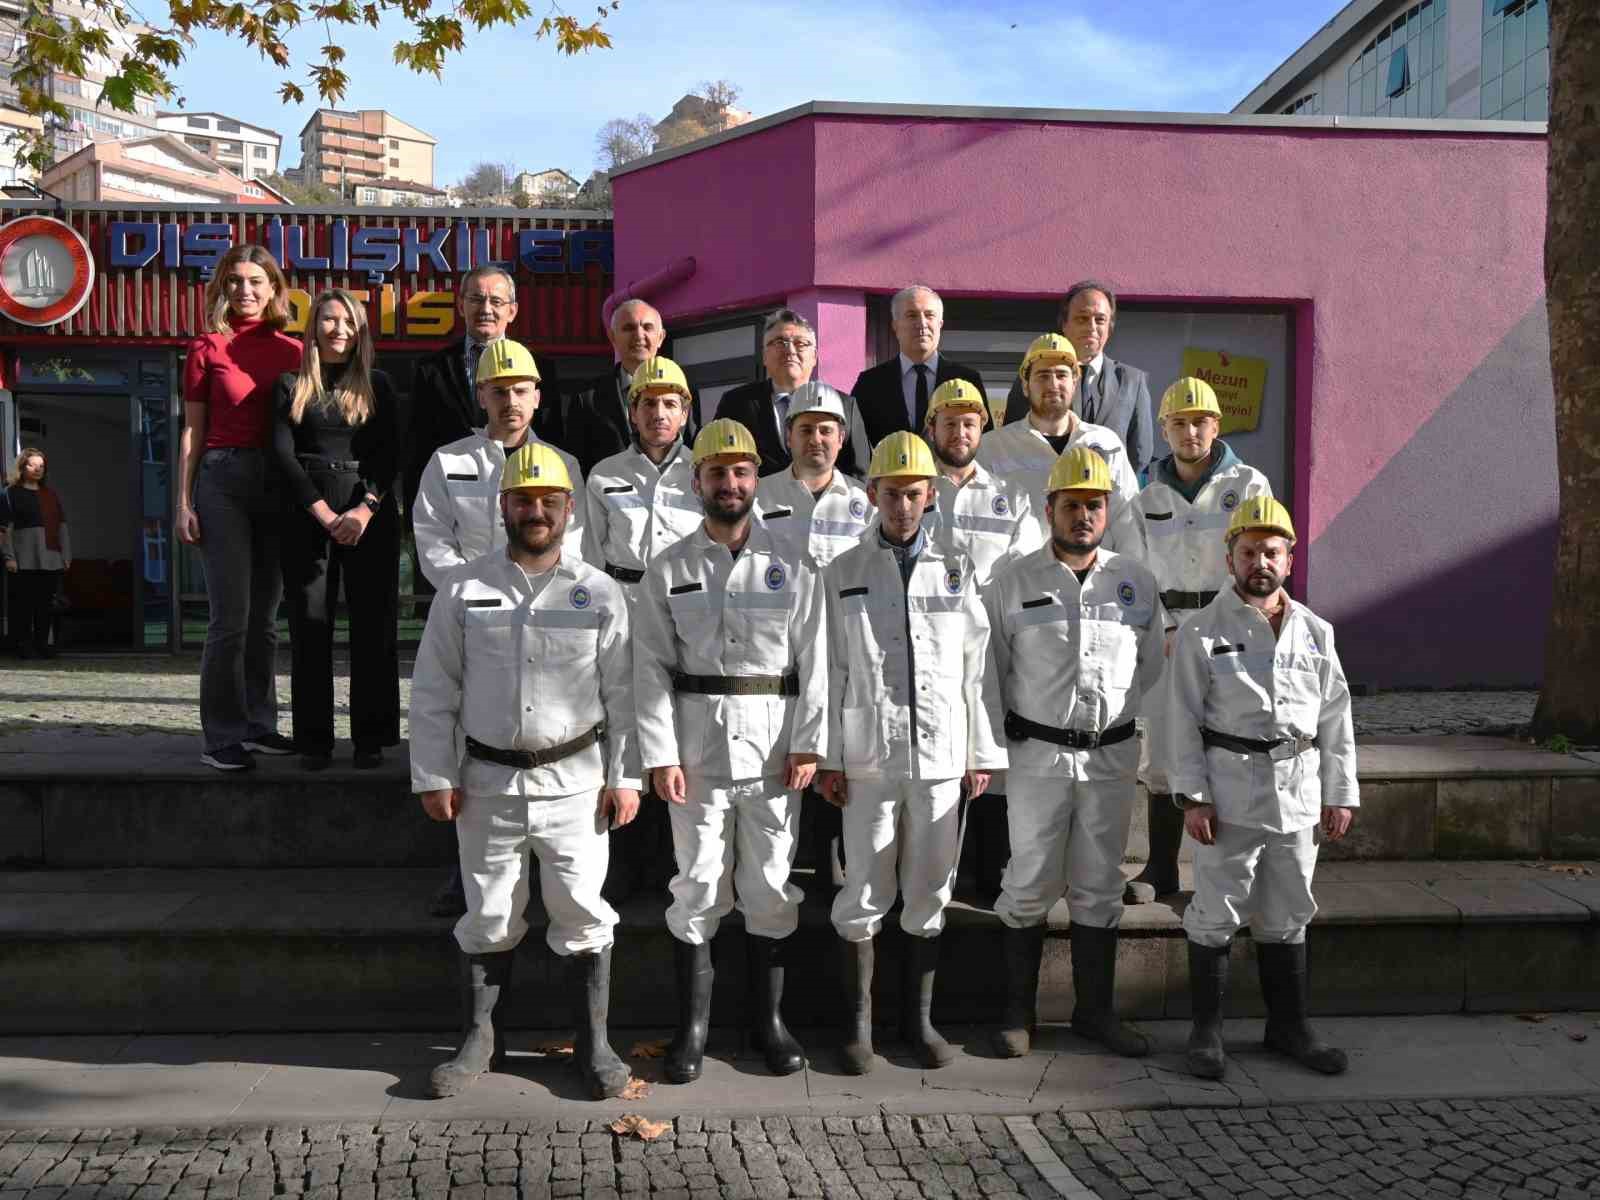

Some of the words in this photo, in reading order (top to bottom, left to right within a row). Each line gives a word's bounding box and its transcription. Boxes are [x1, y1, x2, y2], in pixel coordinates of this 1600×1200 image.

[111, 222, 232, 281] DIŞ
[268, 215, 614, 283] İLİŞKİLER
[1195, 368, 1248, 388] Mezun
